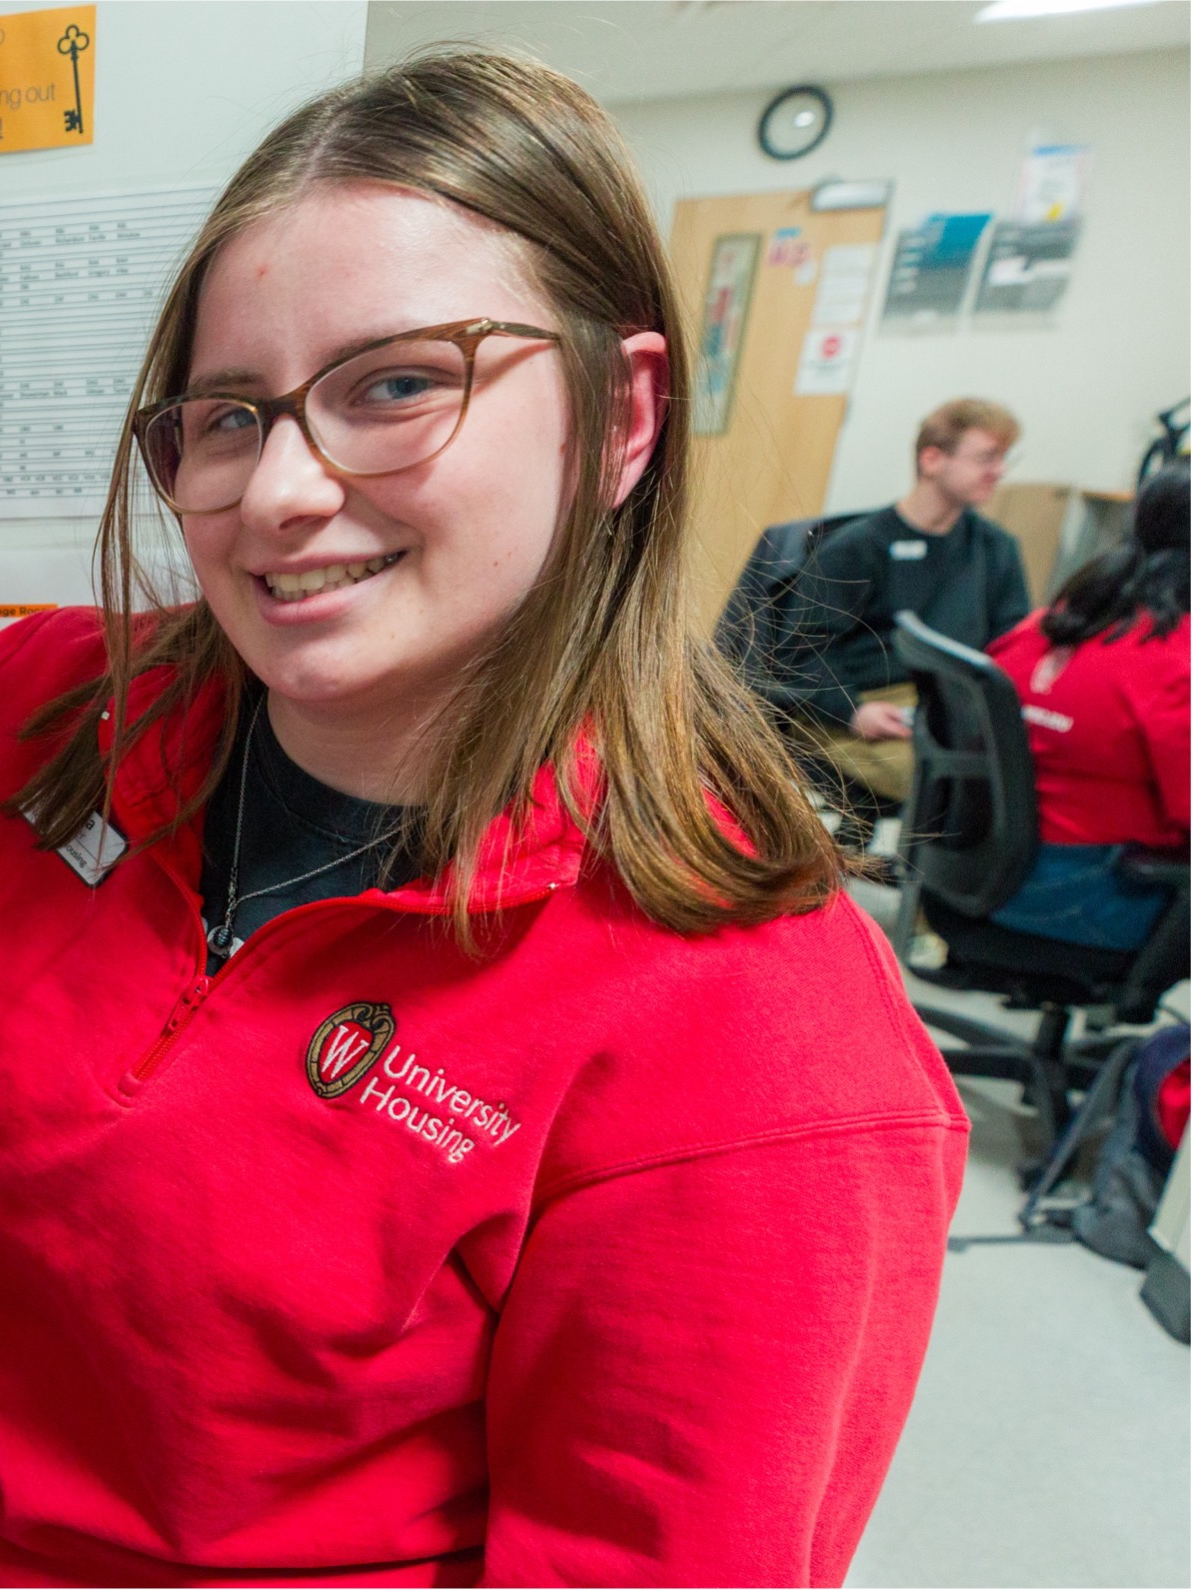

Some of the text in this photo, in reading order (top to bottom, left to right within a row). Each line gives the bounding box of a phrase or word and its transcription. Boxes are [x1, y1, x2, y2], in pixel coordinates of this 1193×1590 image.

[25, 83, 56, 102] out
[65, 844, 88, 869] ousing
[321, 1025, 370, 1079] W
[360, 1077, 475, 1163] Housing
[383, 1045, 522, 1147] University
